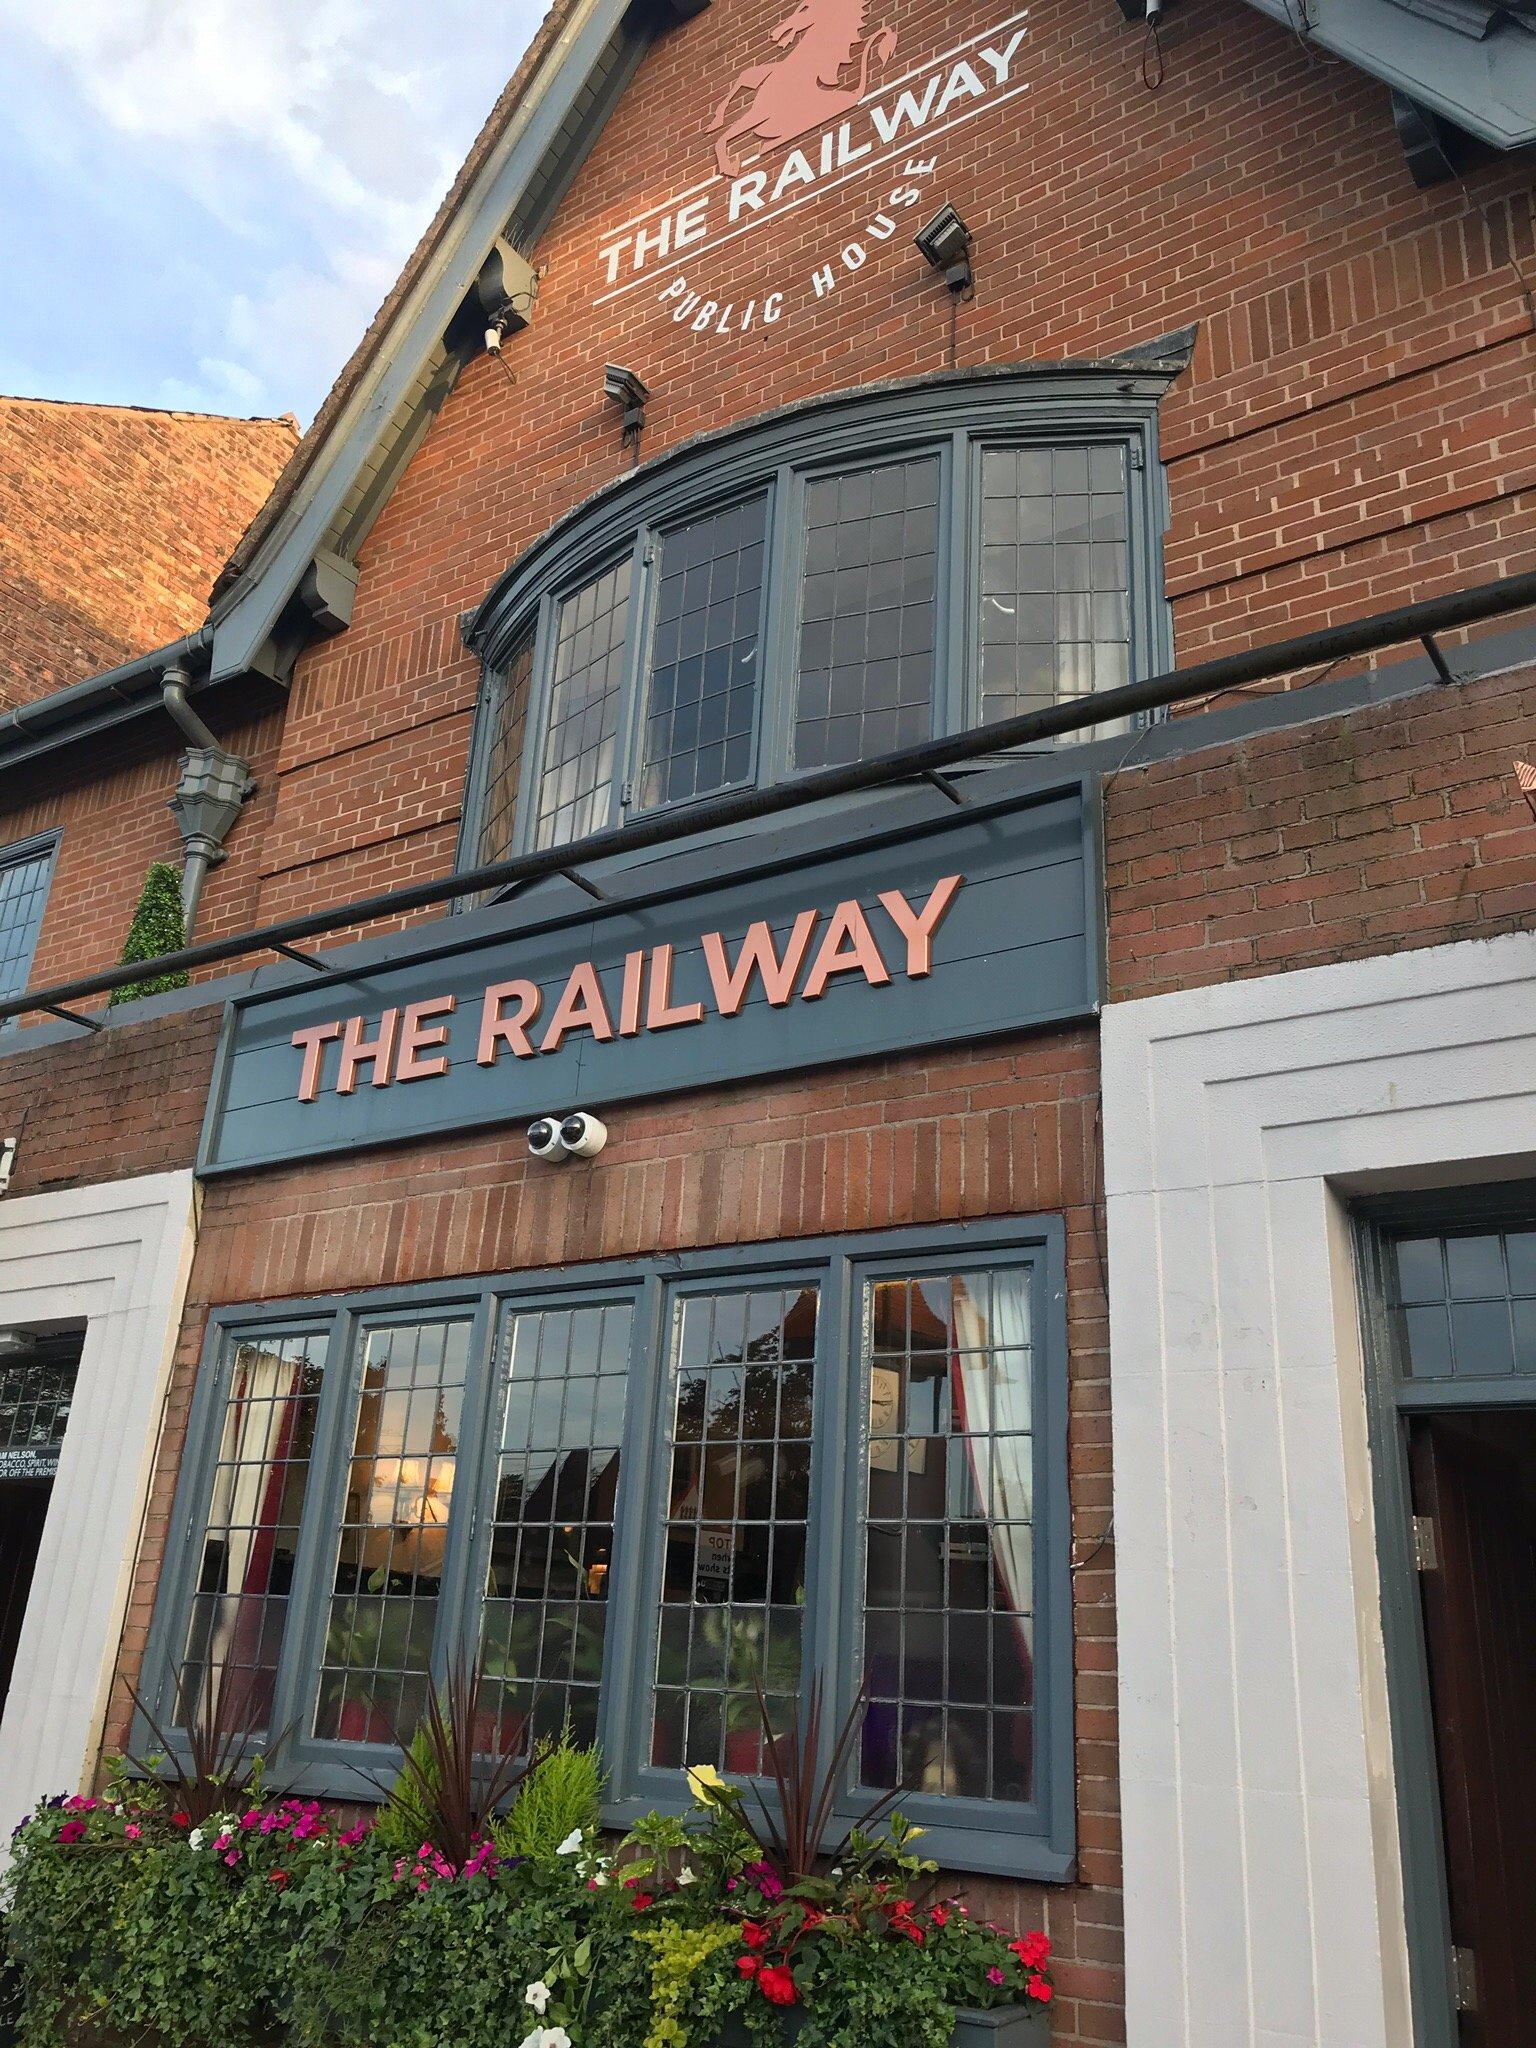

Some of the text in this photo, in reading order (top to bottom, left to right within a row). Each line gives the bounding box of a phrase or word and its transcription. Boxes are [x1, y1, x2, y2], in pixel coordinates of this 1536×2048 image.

[599, 27, 1028, 284] THE RAILWAY
[658, 154, 938, 334] PUBLIC HOUSE
[291, 874, 967, 1103] THE RAILWAY
